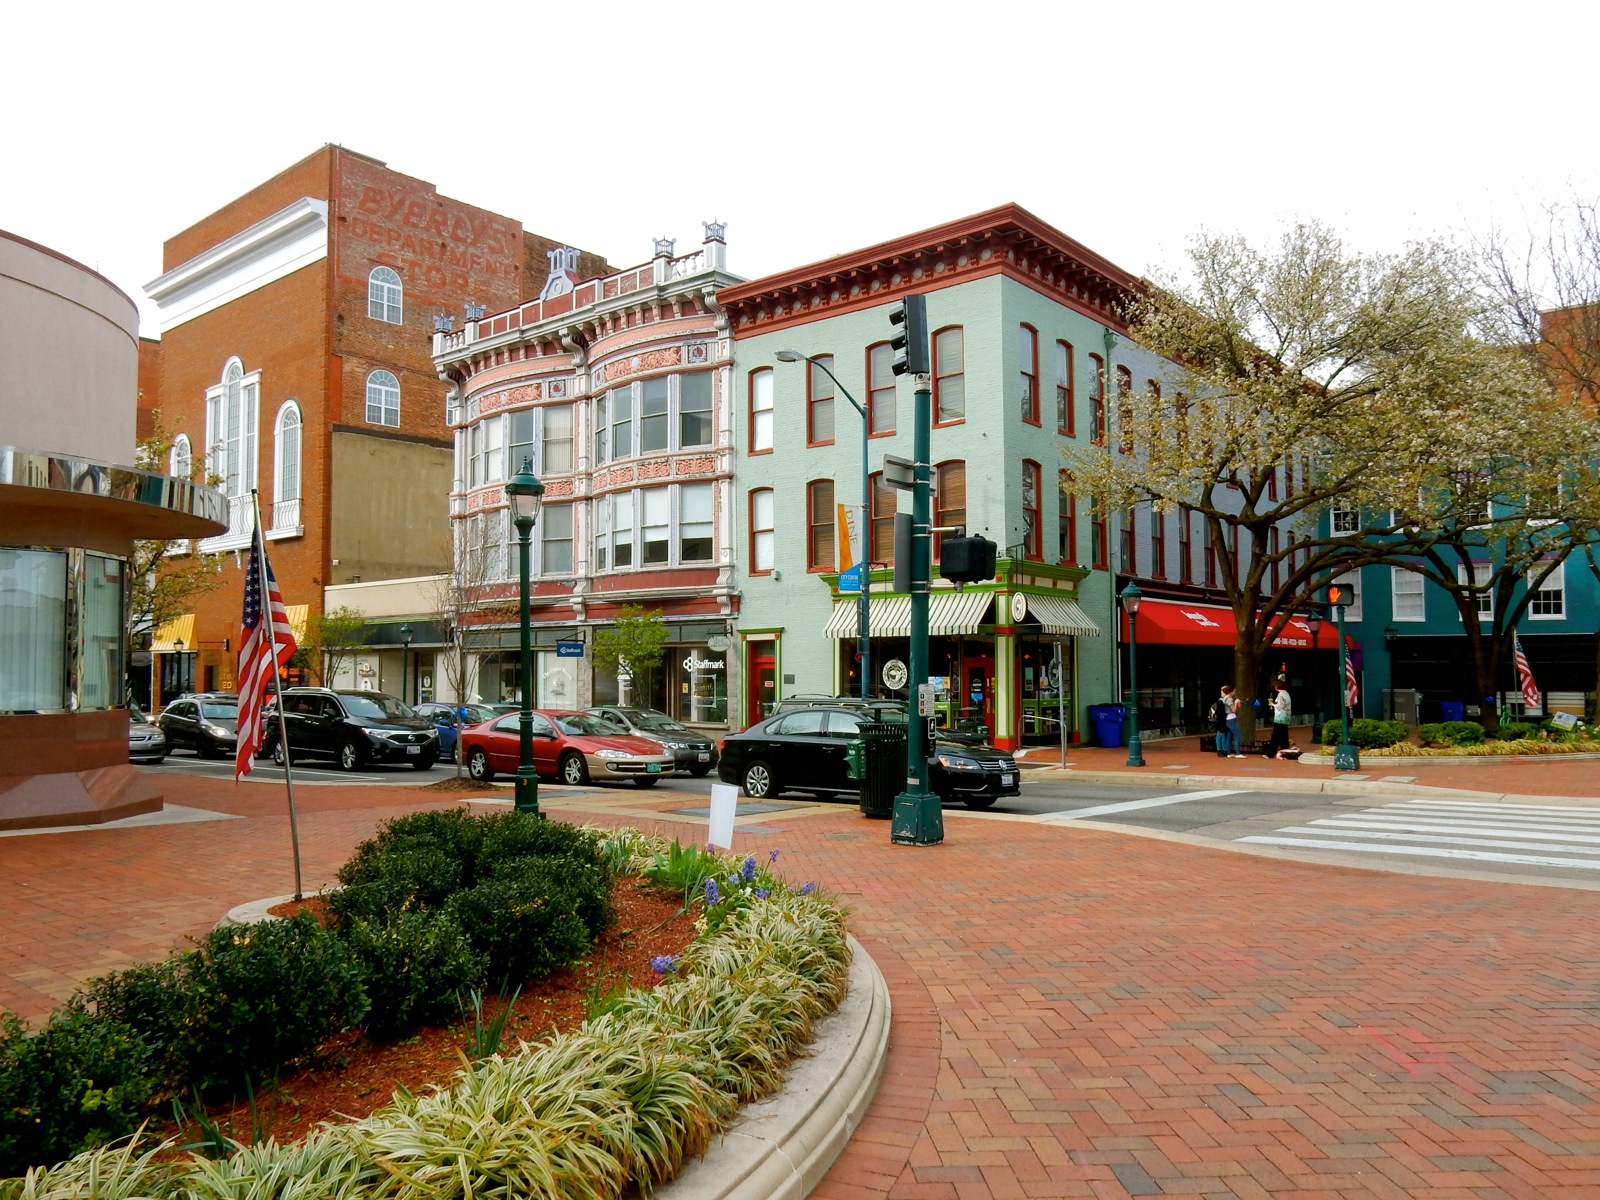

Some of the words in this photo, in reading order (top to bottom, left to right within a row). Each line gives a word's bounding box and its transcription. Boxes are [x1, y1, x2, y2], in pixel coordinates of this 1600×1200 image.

[351, 216, 513, 279] DEPARTMENT
[845, 509, 858, 545] DINE
[693, 659, 725, 669] Staffmark
[222, 681, 233, 689] 20
[522, 778, 528, 786] 3
